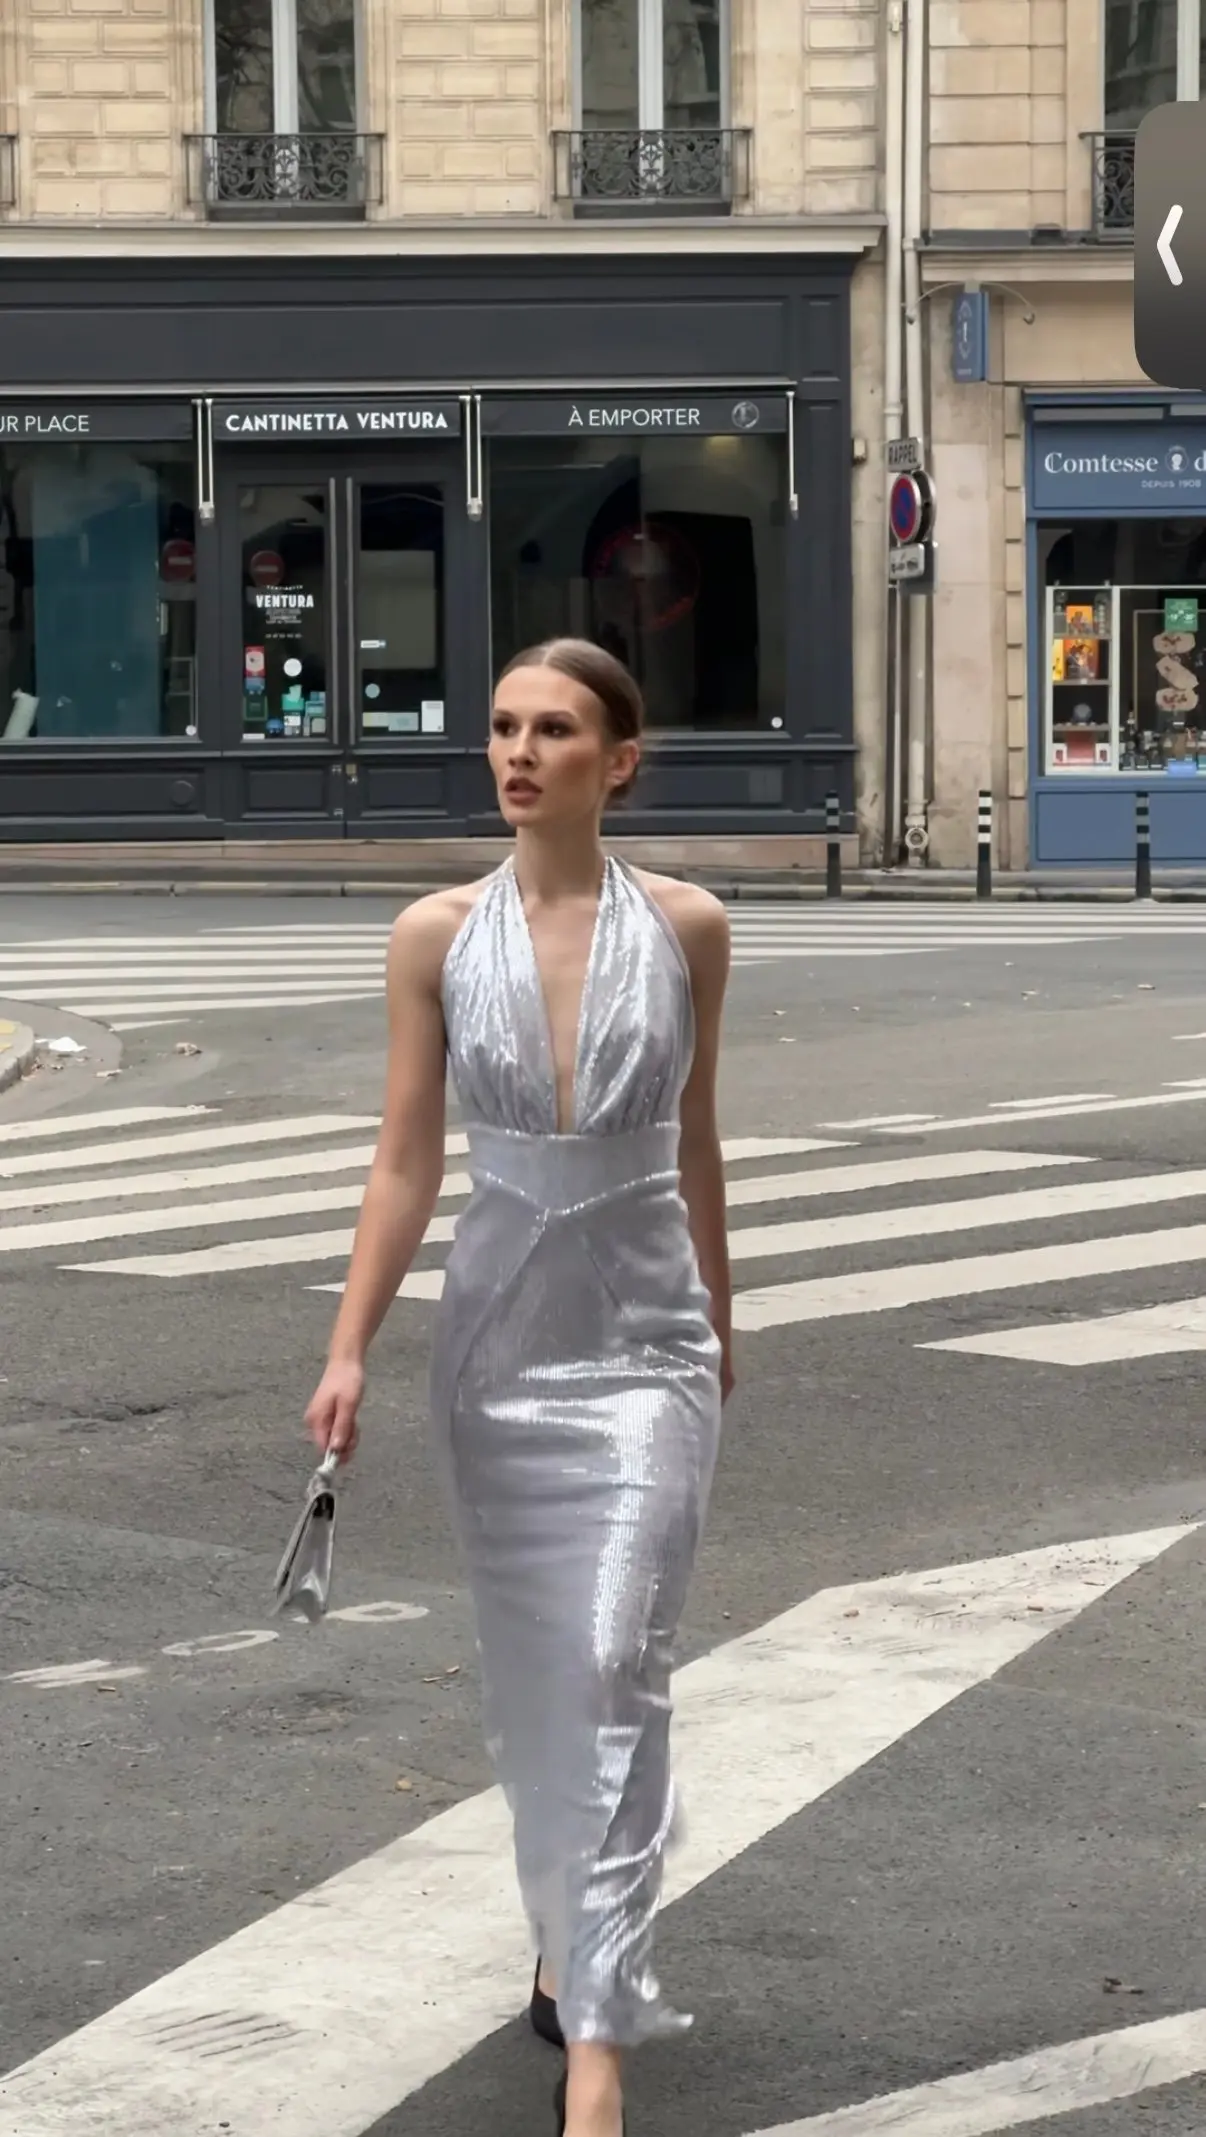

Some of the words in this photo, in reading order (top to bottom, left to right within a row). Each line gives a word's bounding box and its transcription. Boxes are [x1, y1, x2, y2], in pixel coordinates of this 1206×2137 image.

[25, 414, 90, 433] PLACE
[225, 413, 349, 432] CANTINETTA
[356, 411, 448, 430] VENTURA
[568, 405, 583, 426] À
[588, 408, 700, 426] EMPORTER
[888, 444, 917, 466] RAPPEL
[1044, 452, 1159, 474] Comtesse
[1141, 480, 1175, 488] DEPUIS
[255, 594, 315, 608] VENTURA
